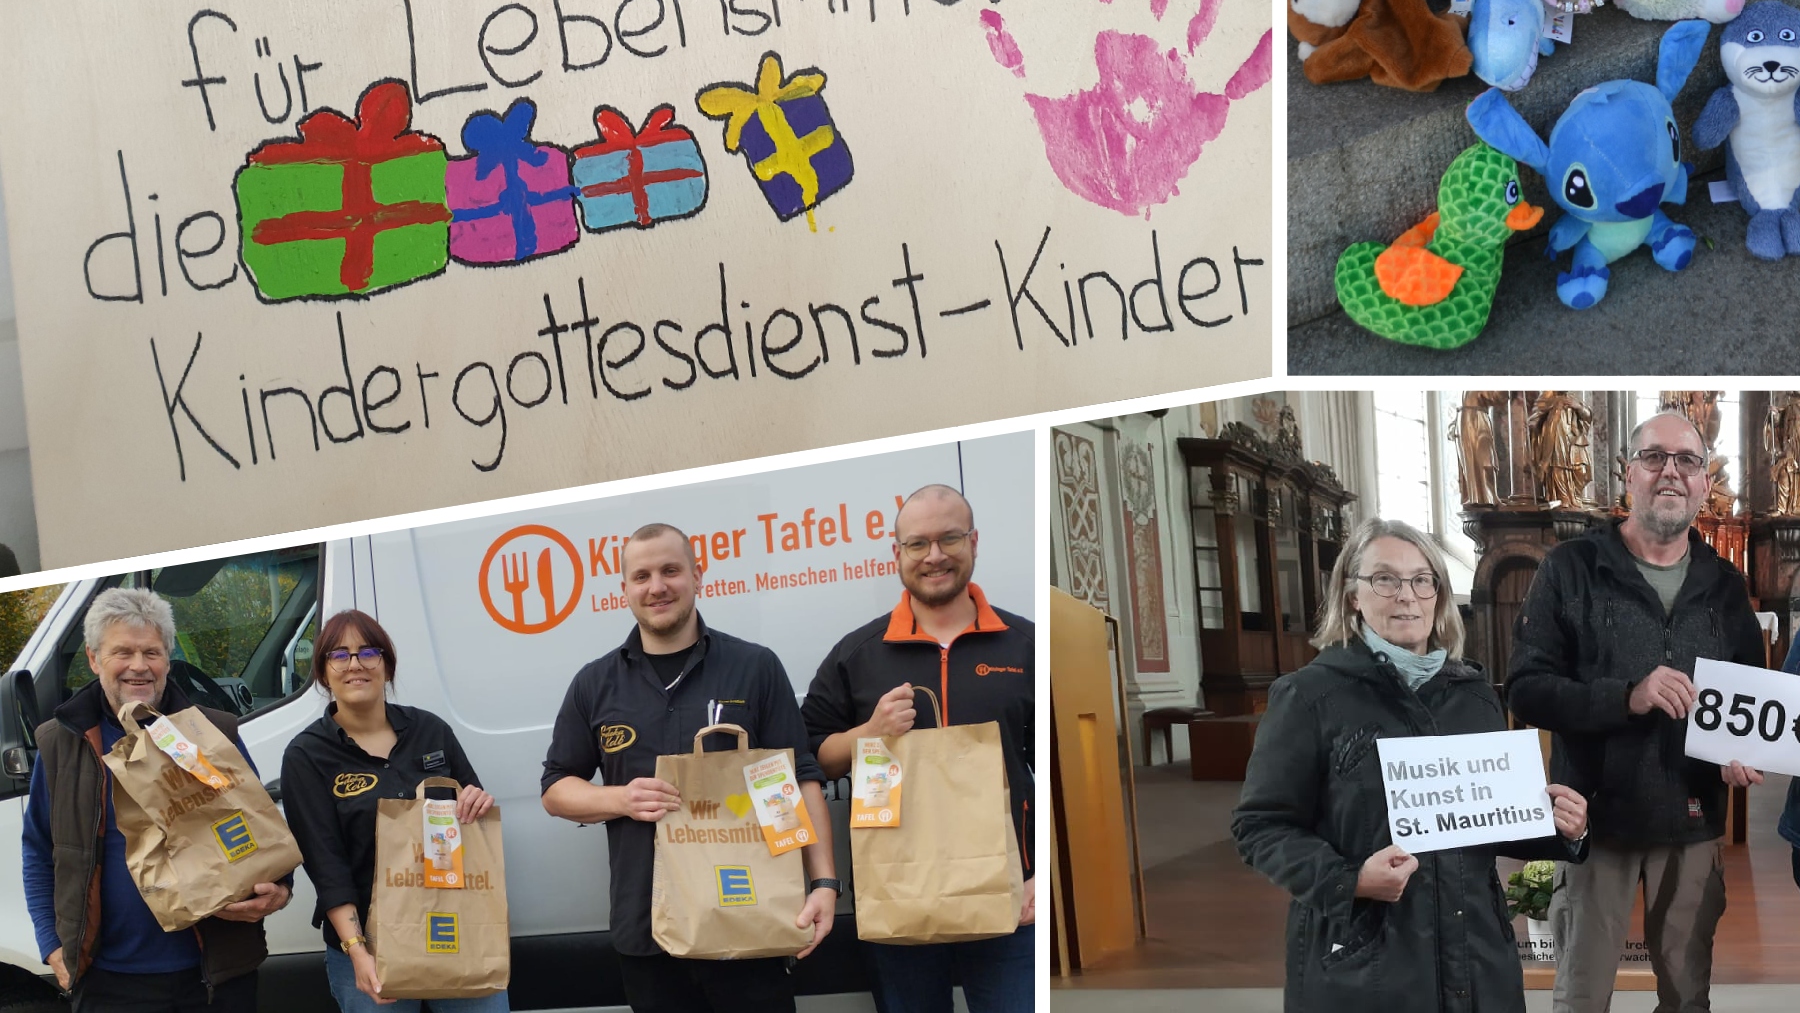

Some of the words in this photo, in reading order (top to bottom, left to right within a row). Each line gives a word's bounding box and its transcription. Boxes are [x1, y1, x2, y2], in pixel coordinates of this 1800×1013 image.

[181, 8, 324, 132] für
[82, 150, 242, 306] die
[150, 225, 1268, 481] Kindergottesdienst-Kinder
[757, 502, 853, 554] Tafel
[755, 565, 836, 592] Menschen
[1387, 754, 1460, 782] Musik
[1467, 751, 1511, 776] und
[1390, 784, 1465, 810] Kunst
[1471, 781, 1493, 803] in
[689, 800, 721, 820] Wir
[856, 813, 875, 822] TAFEL
[1395, 815, 1430, 839] St.
[1436, 804, 1546, 833] Mauritius
[229, 842, 256, 858] EDEKA
[774, 836, 795, 849] TAFEL
[429, 874, 444, 883] TAFEL
[718, 868, 752, 895] E
[430, 916, 456, 942] E
